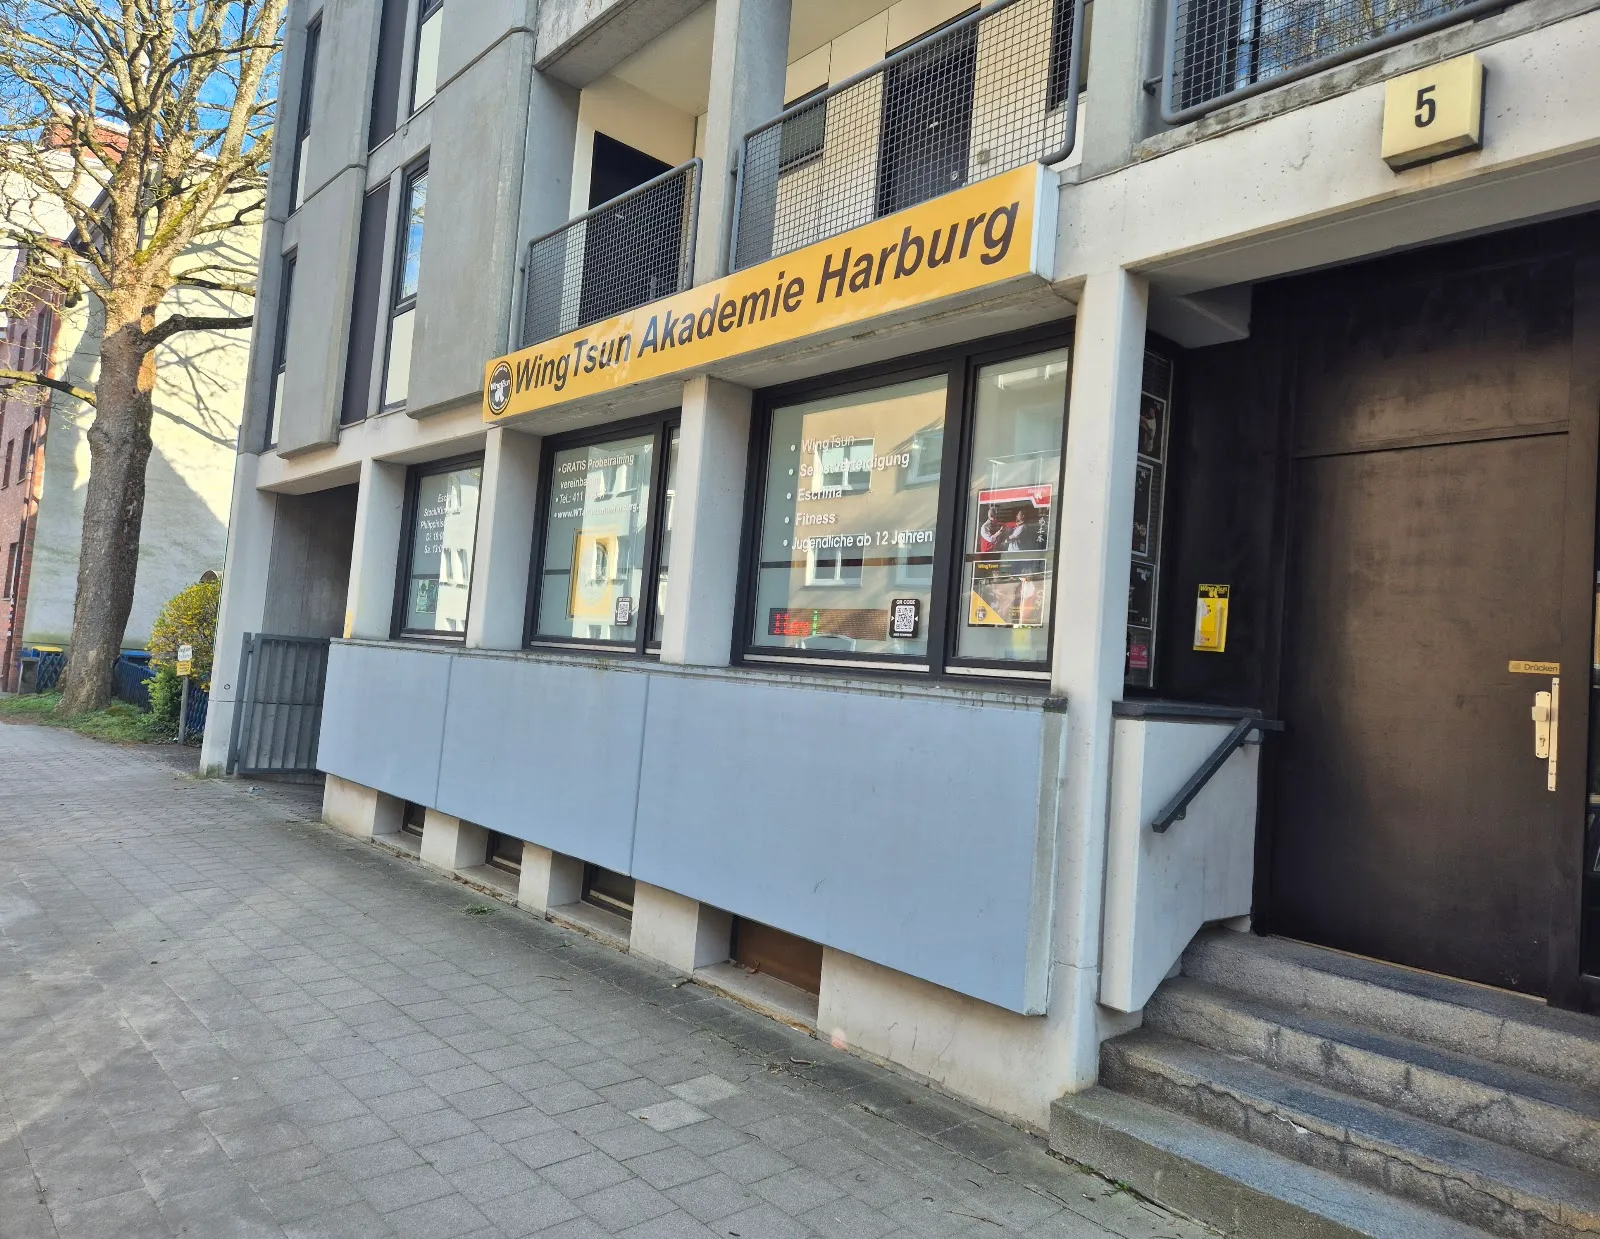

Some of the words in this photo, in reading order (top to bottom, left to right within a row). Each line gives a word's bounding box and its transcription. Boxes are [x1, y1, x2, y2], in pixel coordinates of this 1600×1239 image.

[1414, 84, 1437, 129] 5
[637, 270, 805, 358] Akademie
[816, 201, 1020, 304] Harburg
[561, 460, 587, 474] GRATIS
[587, 453, 635, 470] Probetraining
[800, 452, 910, 477] Sestverteidigung
[797, 488, 842, 502] Escrima
[796, 512, 836, 526] Fitness
[791, 533, 854, 552] Jugendliche
[856, 532, 872, 546] ab
[875, 530, 889, 545] 12
[892, 530, 933, 545] Jahren
[1524, 663, 1558, 672] Drücken
